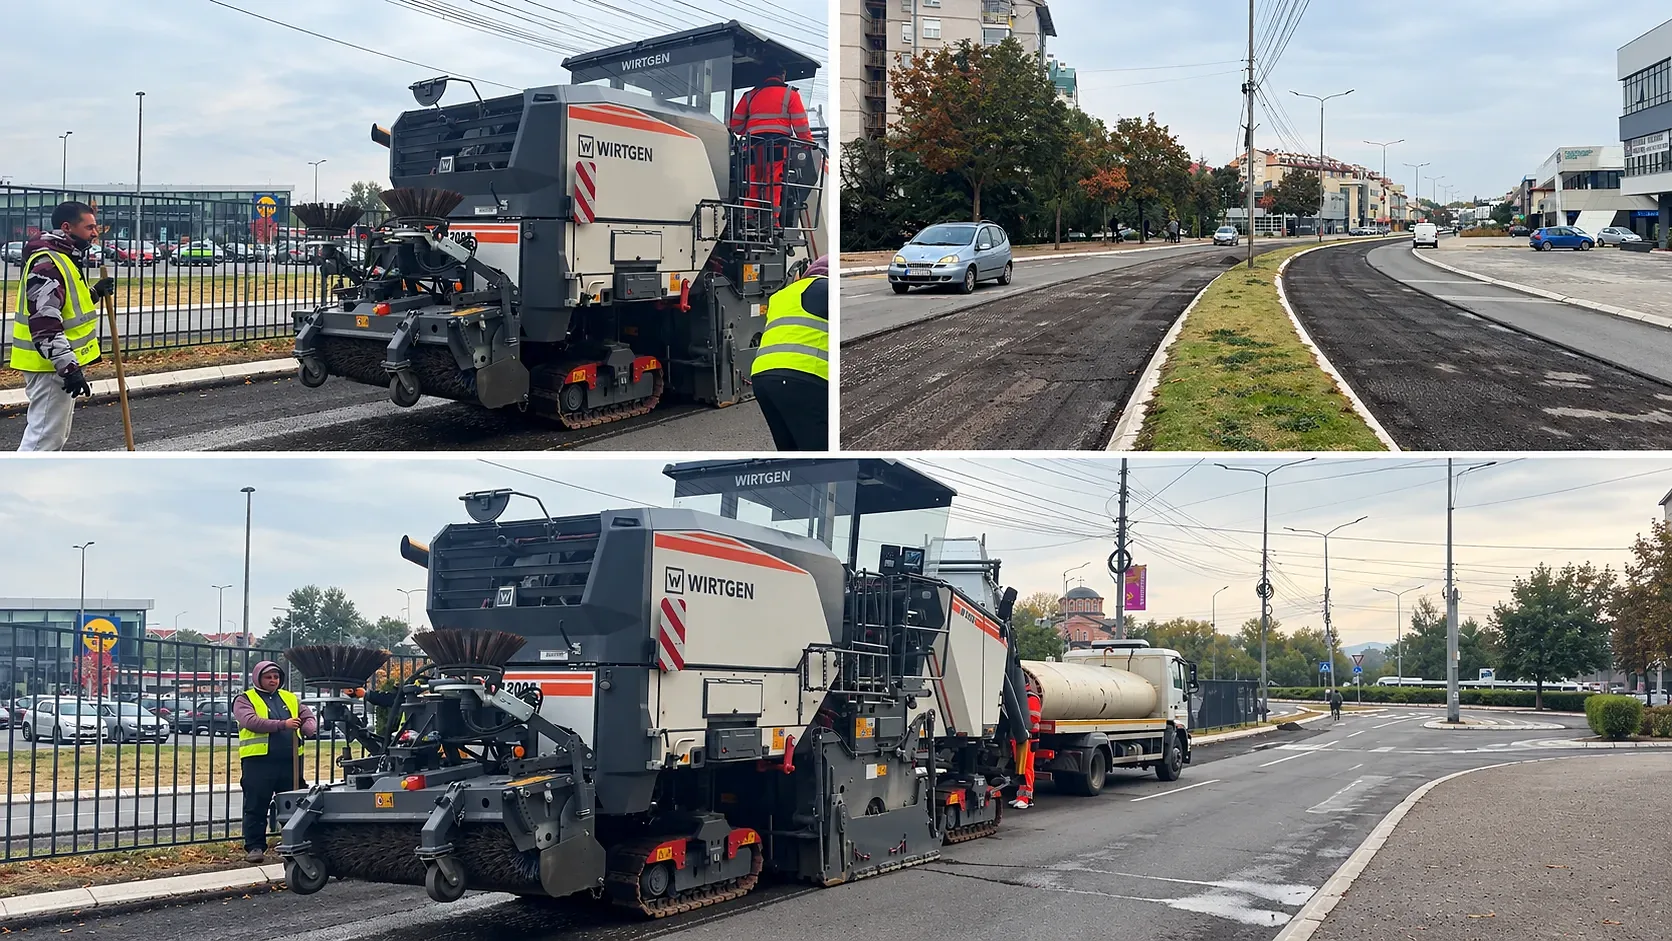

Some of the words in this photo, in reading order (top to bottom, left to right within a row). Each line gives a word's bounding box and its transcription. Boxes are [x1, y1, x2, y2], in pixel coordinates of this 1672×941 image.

[621, 52, 670, 71] WIRTGEN
[597, 141, 653, 162] WIRTGEN
[735, 470, 791, 487] WIRTGEN
[688, 574, 754, 600] WIRTGEN
